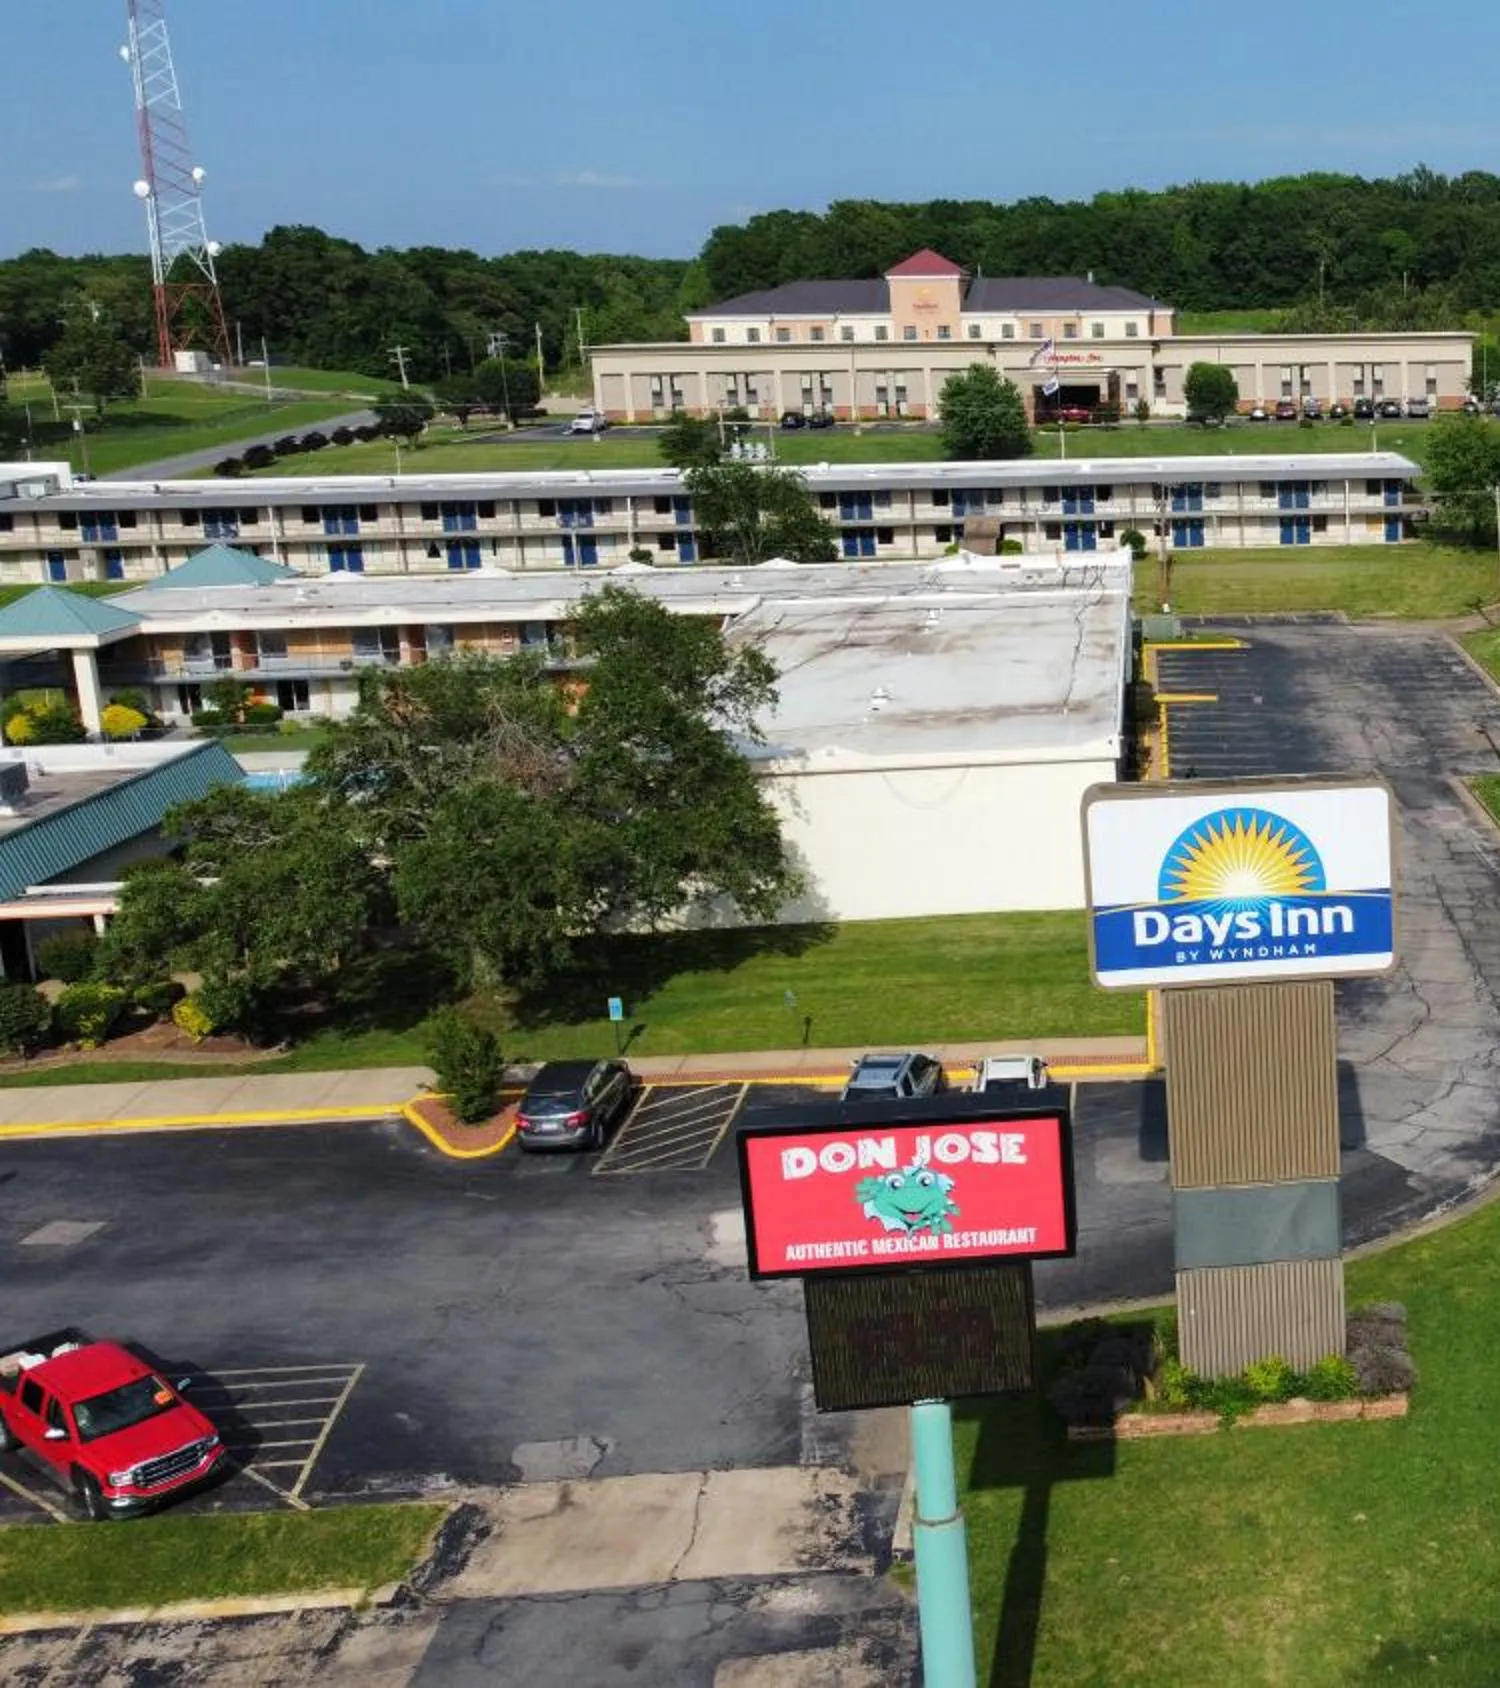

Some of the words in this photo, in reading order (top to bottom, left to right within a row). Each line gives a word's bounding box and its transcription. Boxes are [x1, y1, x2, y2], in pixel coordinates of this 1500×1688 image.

[1134, 911, 1262, 946] Days
[1270, 904, 1354, 937] Inn
[1176, 950, 1200, 963] BY
[1209, 944, 1316, 960] WYNDHAM
[782, 1137, 897, 1180] DON
[912, 1132, 1027, 1169] JOSE
[785, 1241, 868, 1261] AUTHENTIC
[873, 1237, 939, 1256] MEXICAN
[943, 1229, 1037, 1250] RESTAURANT
